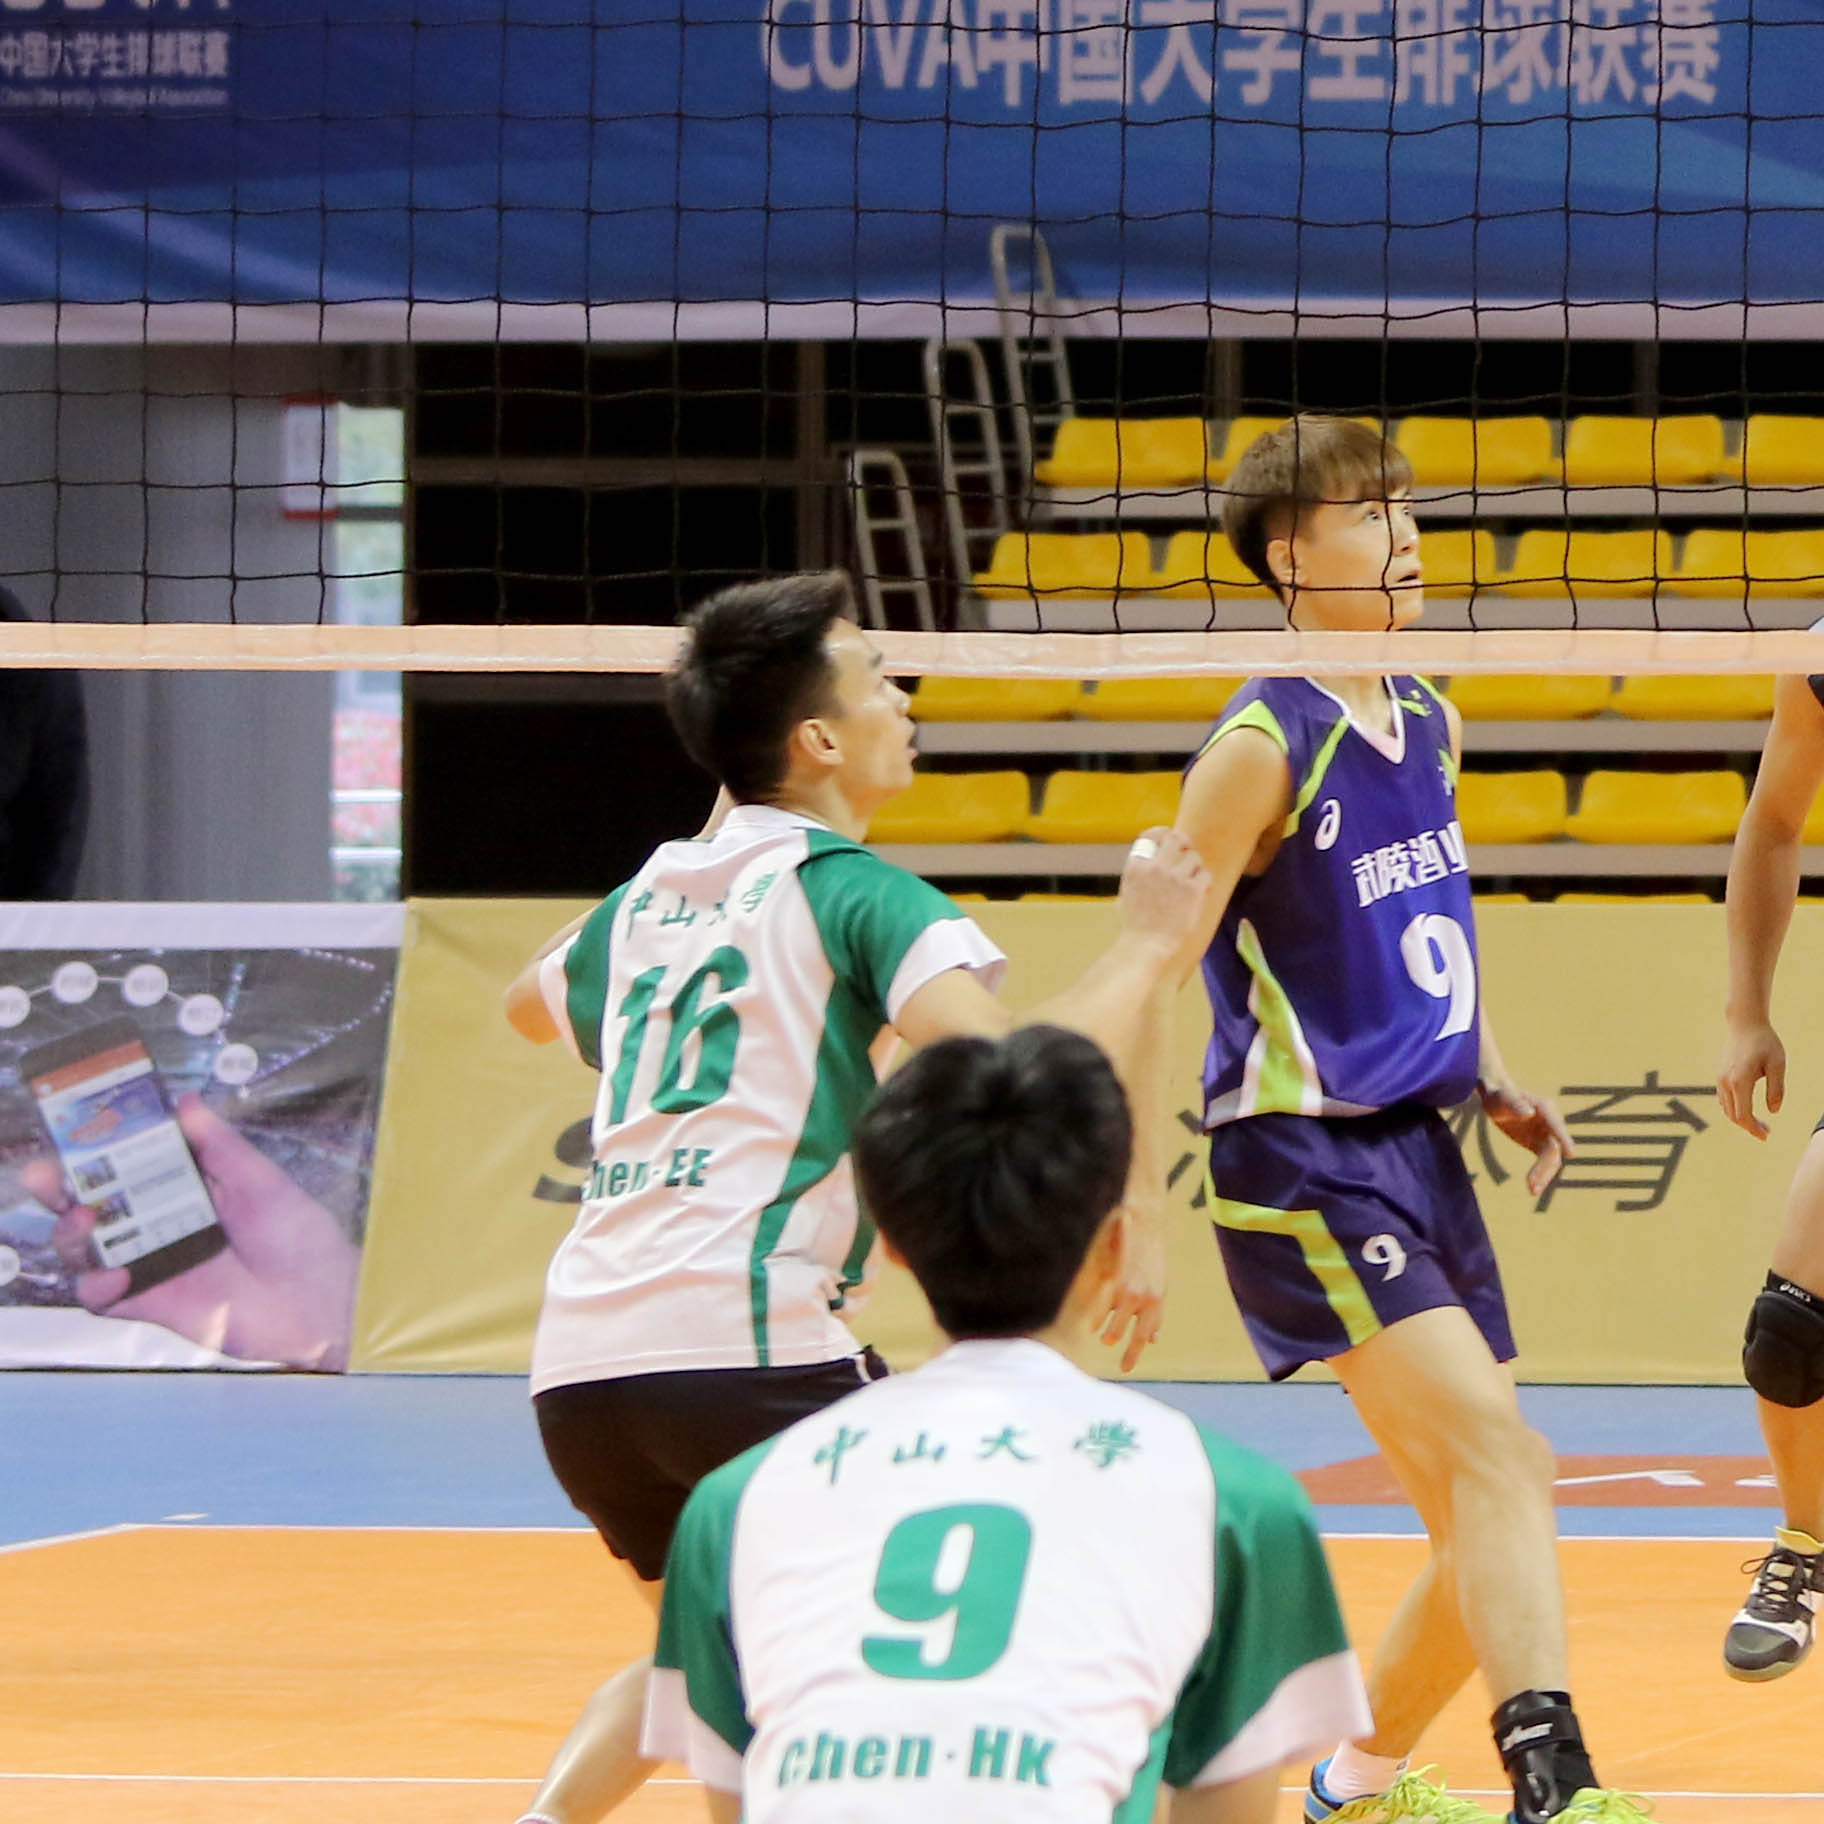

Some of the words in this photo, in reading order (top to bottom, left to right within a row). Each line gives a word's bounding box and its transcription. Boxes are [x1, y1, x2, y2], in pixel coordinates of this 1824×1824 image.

[607, 944, 749, 1125] 16
[1401, 913, 1476, 1043] 9
[1361, 1233, 1406, 1282] 9
[861, 1502, 1033, 1682] 9
